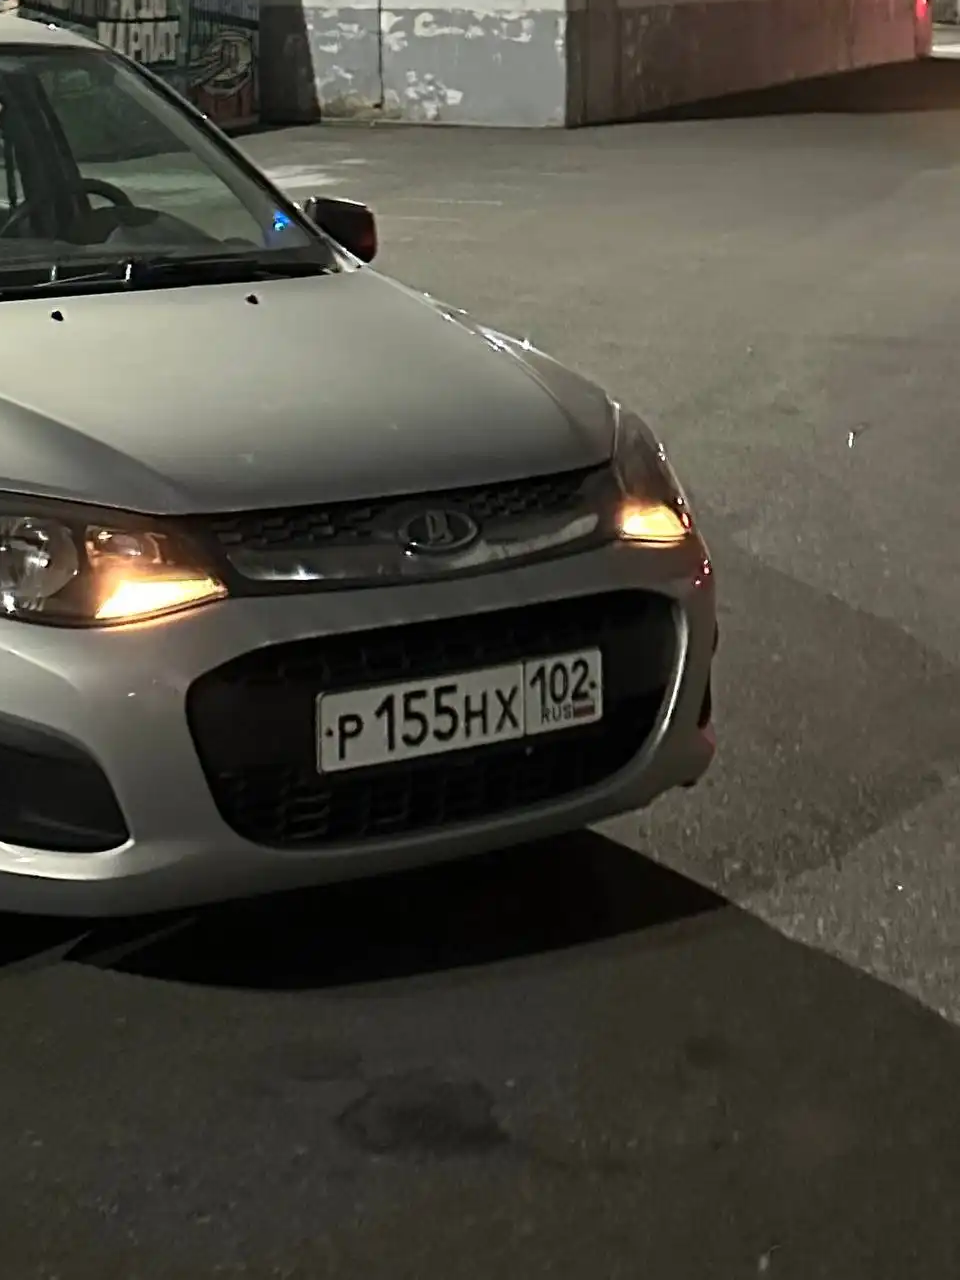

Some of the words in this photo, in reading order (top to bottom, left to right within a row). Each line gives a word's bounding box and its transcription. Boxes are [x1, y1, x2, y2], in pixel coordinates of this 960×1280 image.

[337, 684, 520, 761] Р155НХ
[530, 659, 589, 707] 102
[541, 702, 572, 725] RUS
